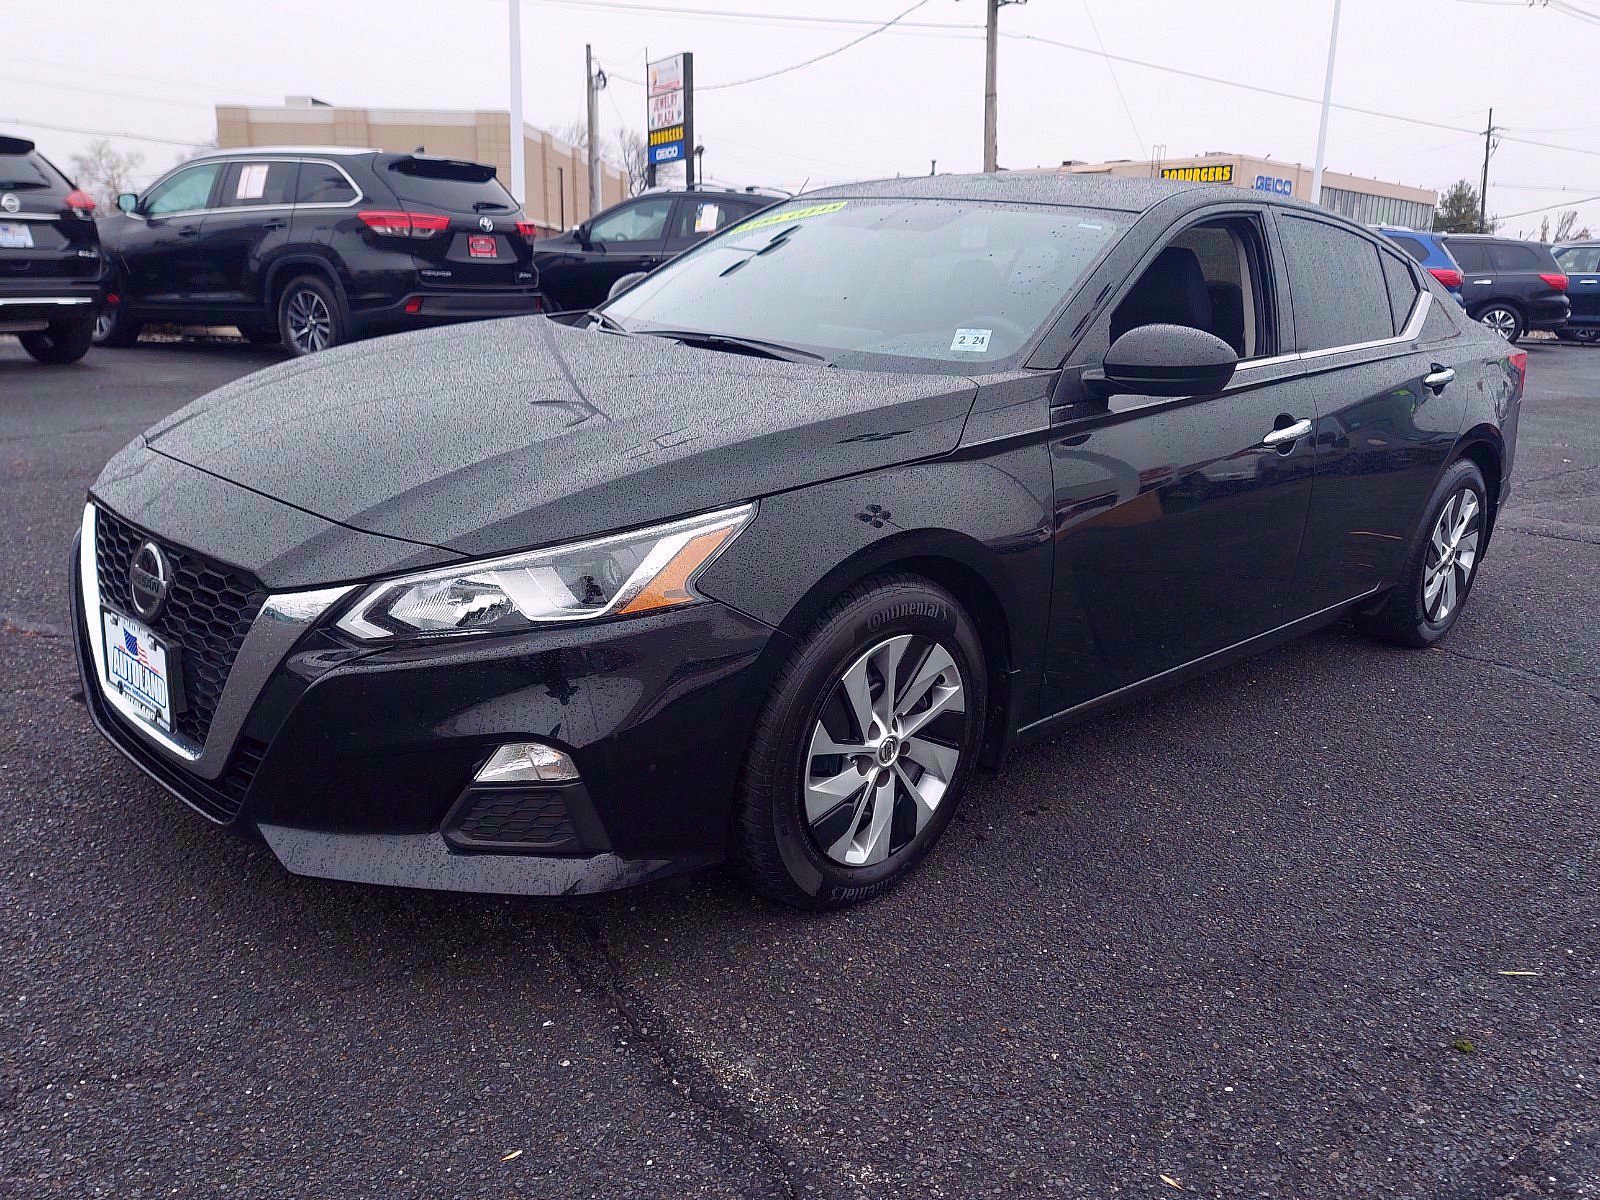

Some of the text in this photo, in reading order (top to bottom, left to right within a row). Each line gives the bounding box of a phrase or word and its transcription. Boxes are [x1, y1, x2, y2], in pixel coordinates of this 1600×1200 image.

[1255, 175, 1293, 196] GEICO
[958, 335, 985, 345] 2 24
[866, 602, 940, 633] Continental
[113, 646, 167, 708] AUTOLAND
